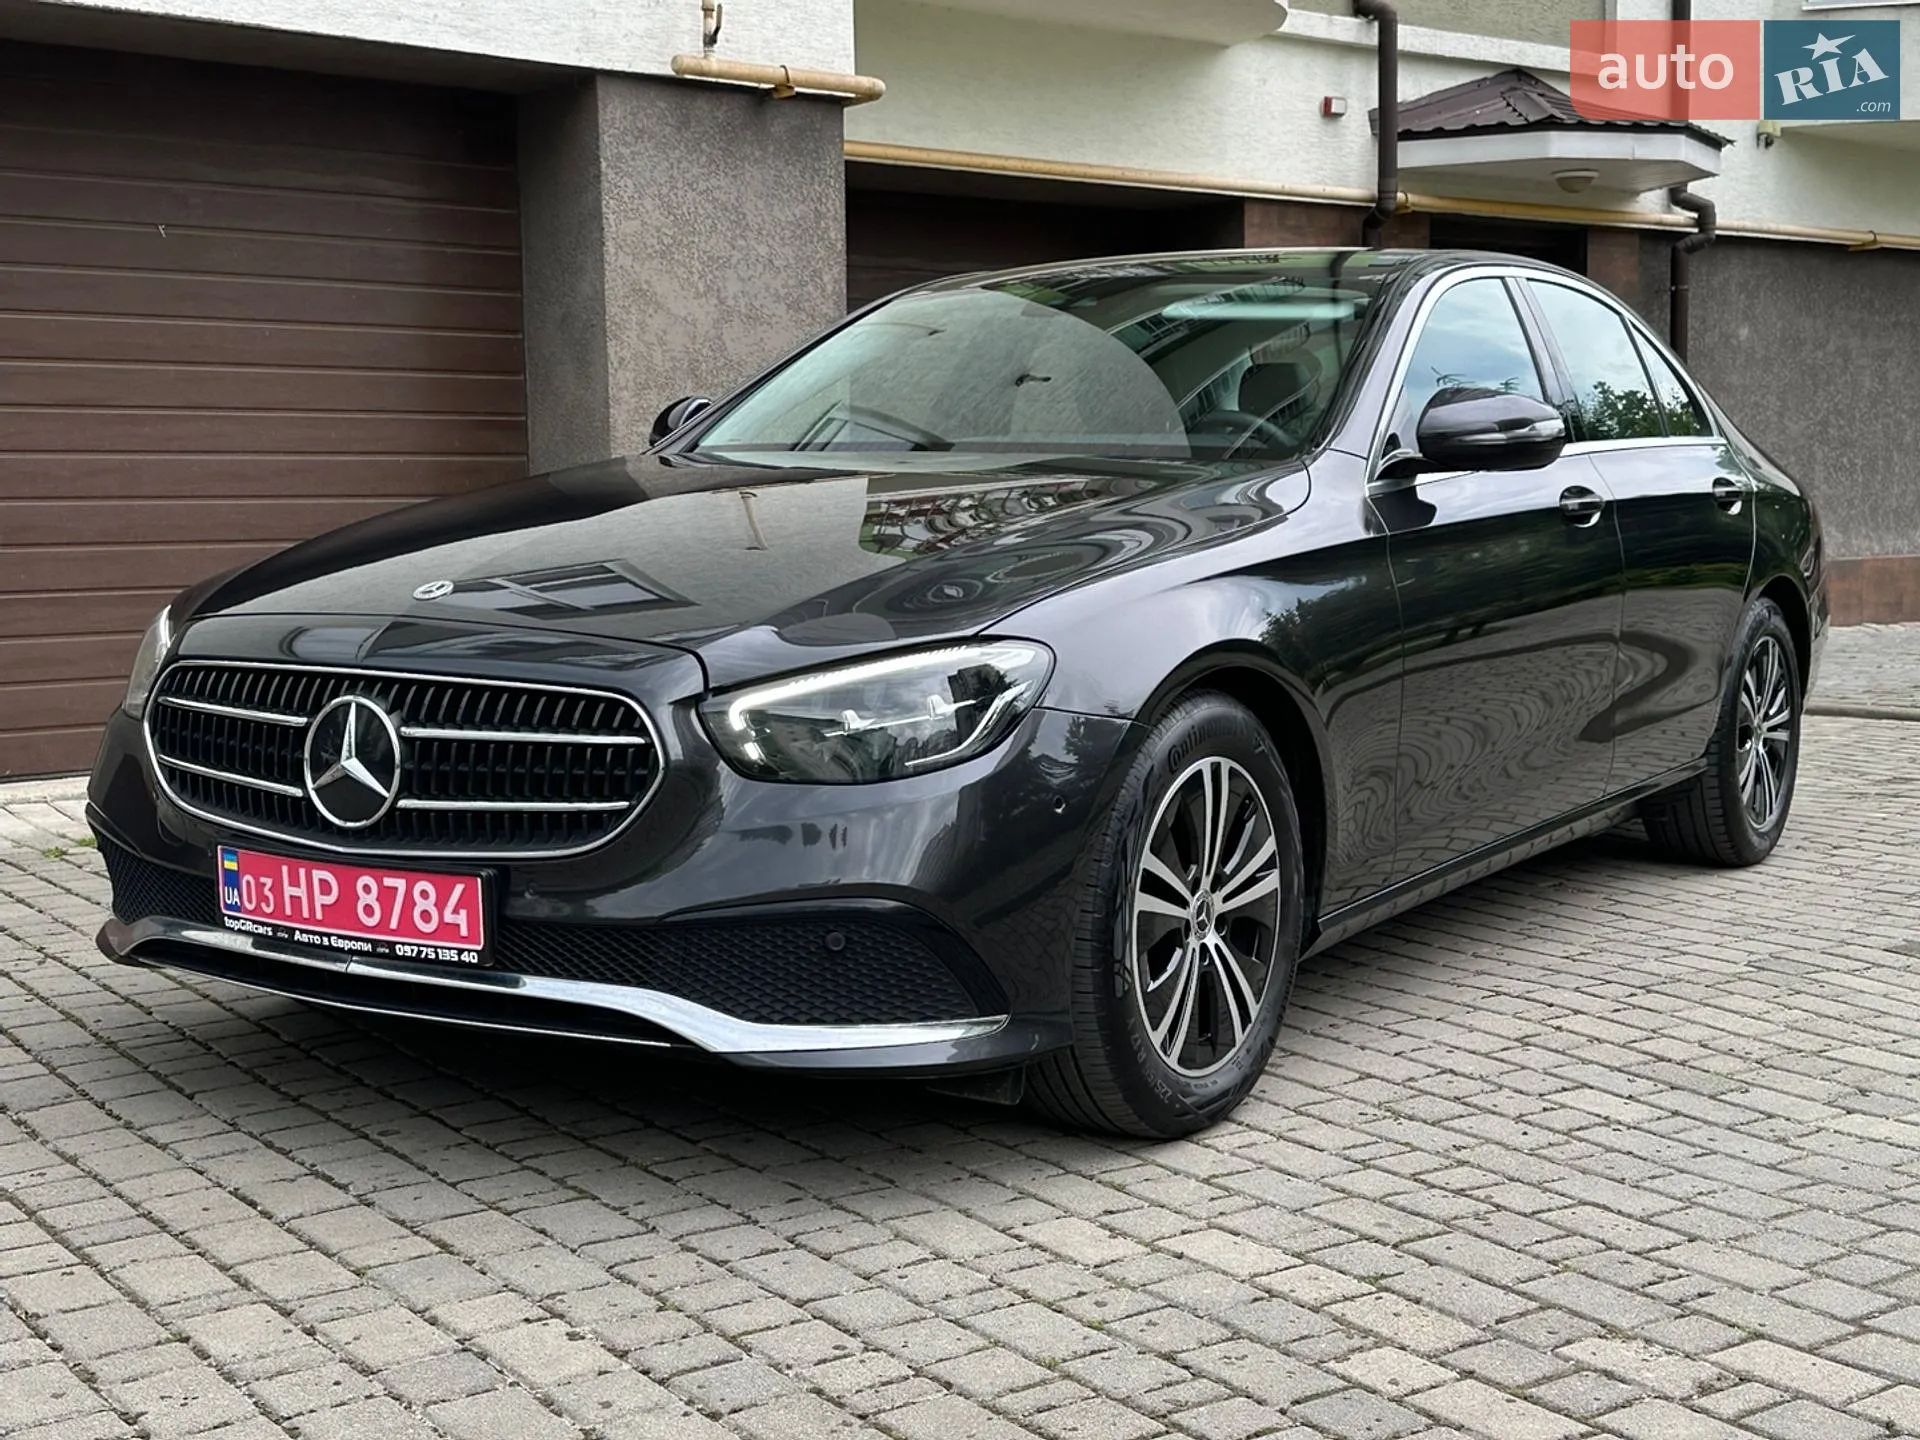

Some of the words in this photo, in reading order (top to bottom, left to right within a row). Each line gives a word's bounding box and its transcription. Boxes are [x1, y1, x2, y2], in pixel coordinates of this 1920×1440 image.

[224, 886, 241, 907] UA
[242, 874, 275, 914] 03
[281, 865, 339, 921] HP
[356, 875, 469, 938] 8784
[294, 930, 321, 945] Авто
[460, 951, 478, 963] 40
